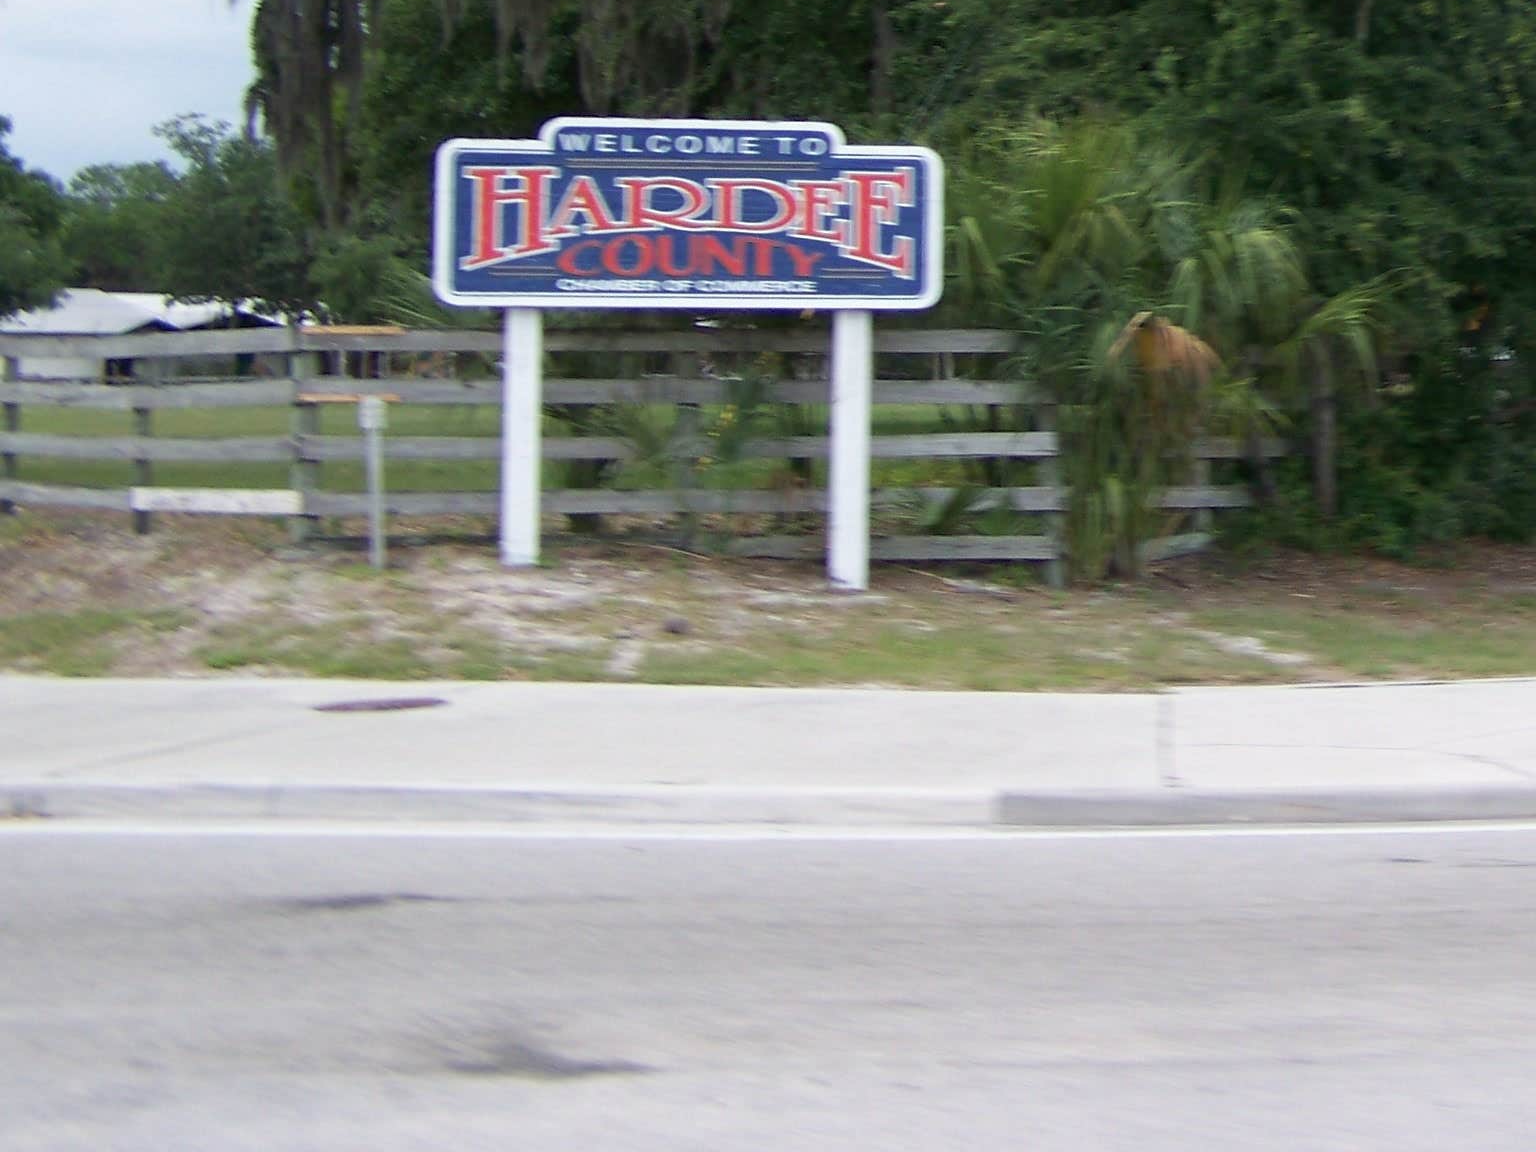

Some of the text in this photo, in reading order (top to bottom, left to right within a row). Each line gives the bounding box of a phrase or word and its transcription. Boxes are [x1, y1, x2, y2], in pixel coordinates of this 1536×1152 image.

[558, 133, 828, 156] WELCOME TO
[459, 165, 916, 279] HARDEE
[557, 234, 824, 277] COUNTY
[555, 278, 819, 293] CHAMBER OF COMMERCE
